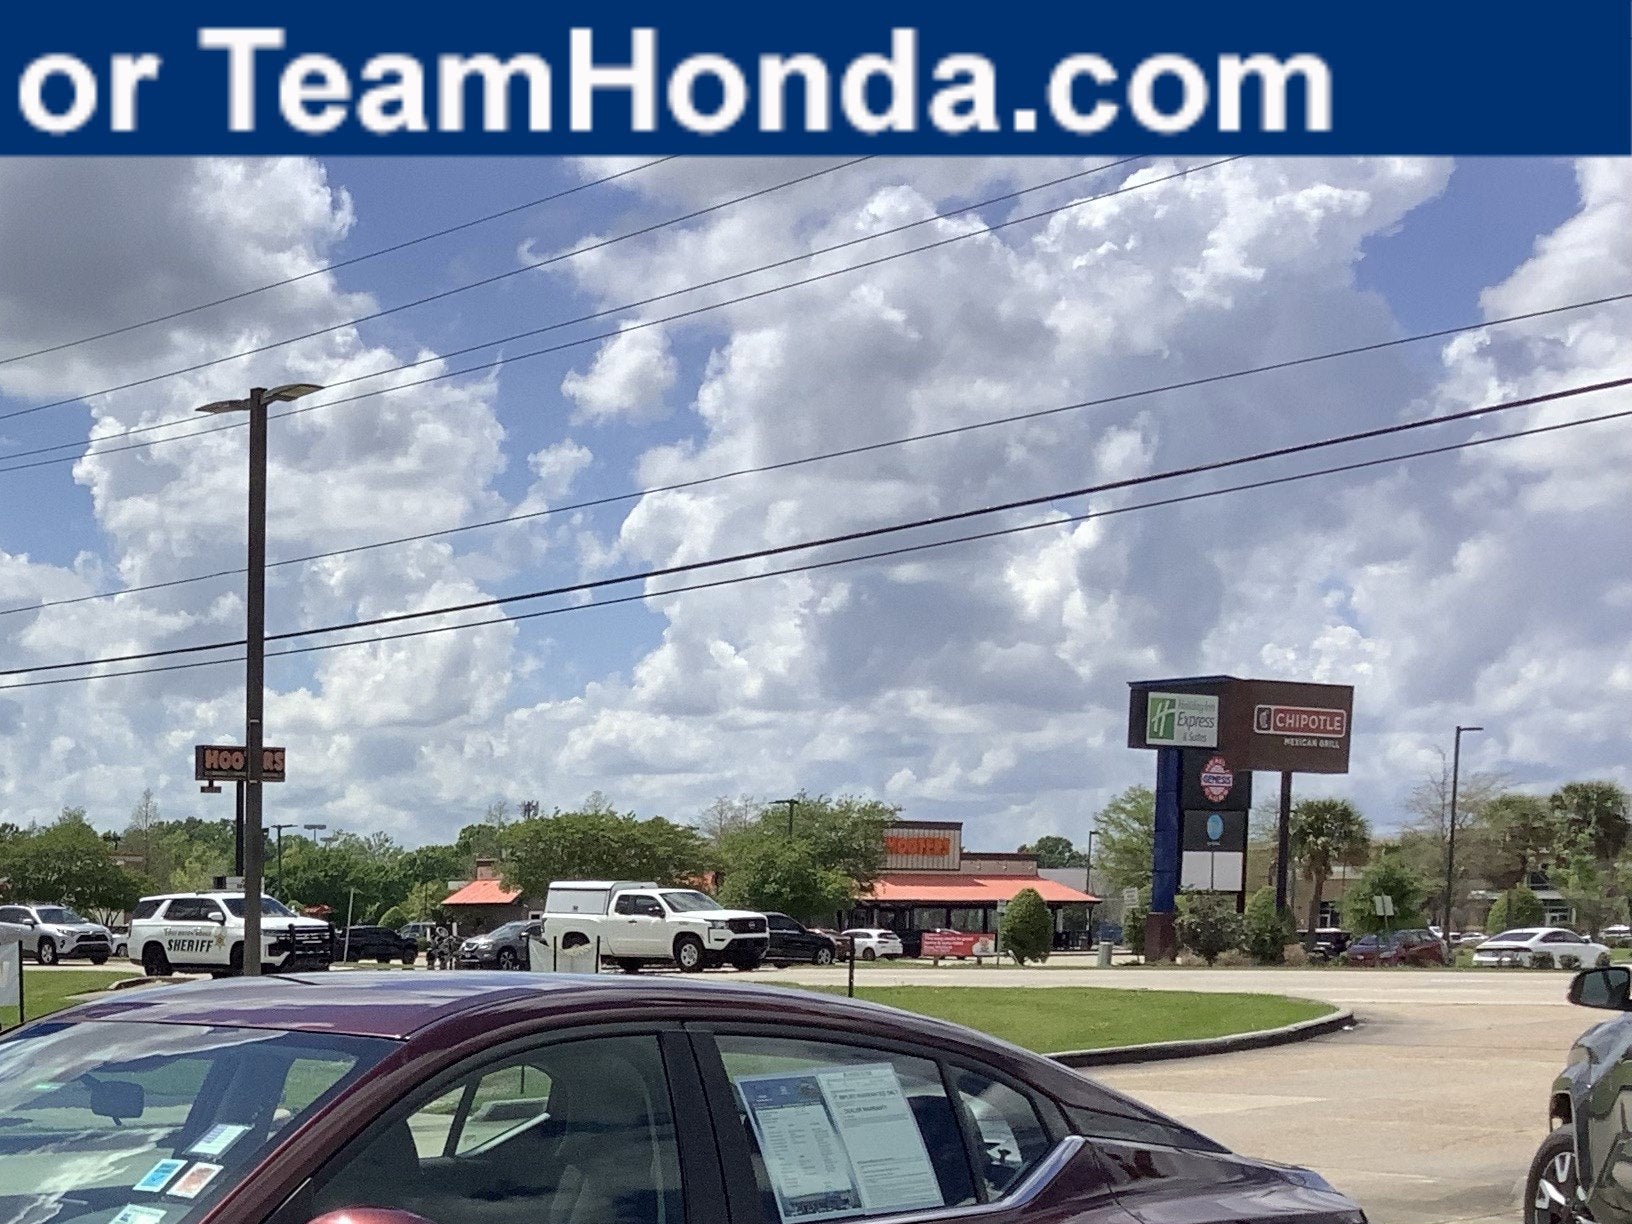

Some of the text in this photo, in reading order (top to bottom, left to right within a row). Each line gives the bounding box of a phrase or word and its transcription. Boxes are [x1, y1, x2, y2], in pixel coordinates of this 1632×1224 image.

[1177, 711, 1215, 730] Express
[1275, 712, 1342, 731] CHIPOTLE
[205, 750, 284, 771] HOORS
[167, 939, 214, 952] SHERIFF
